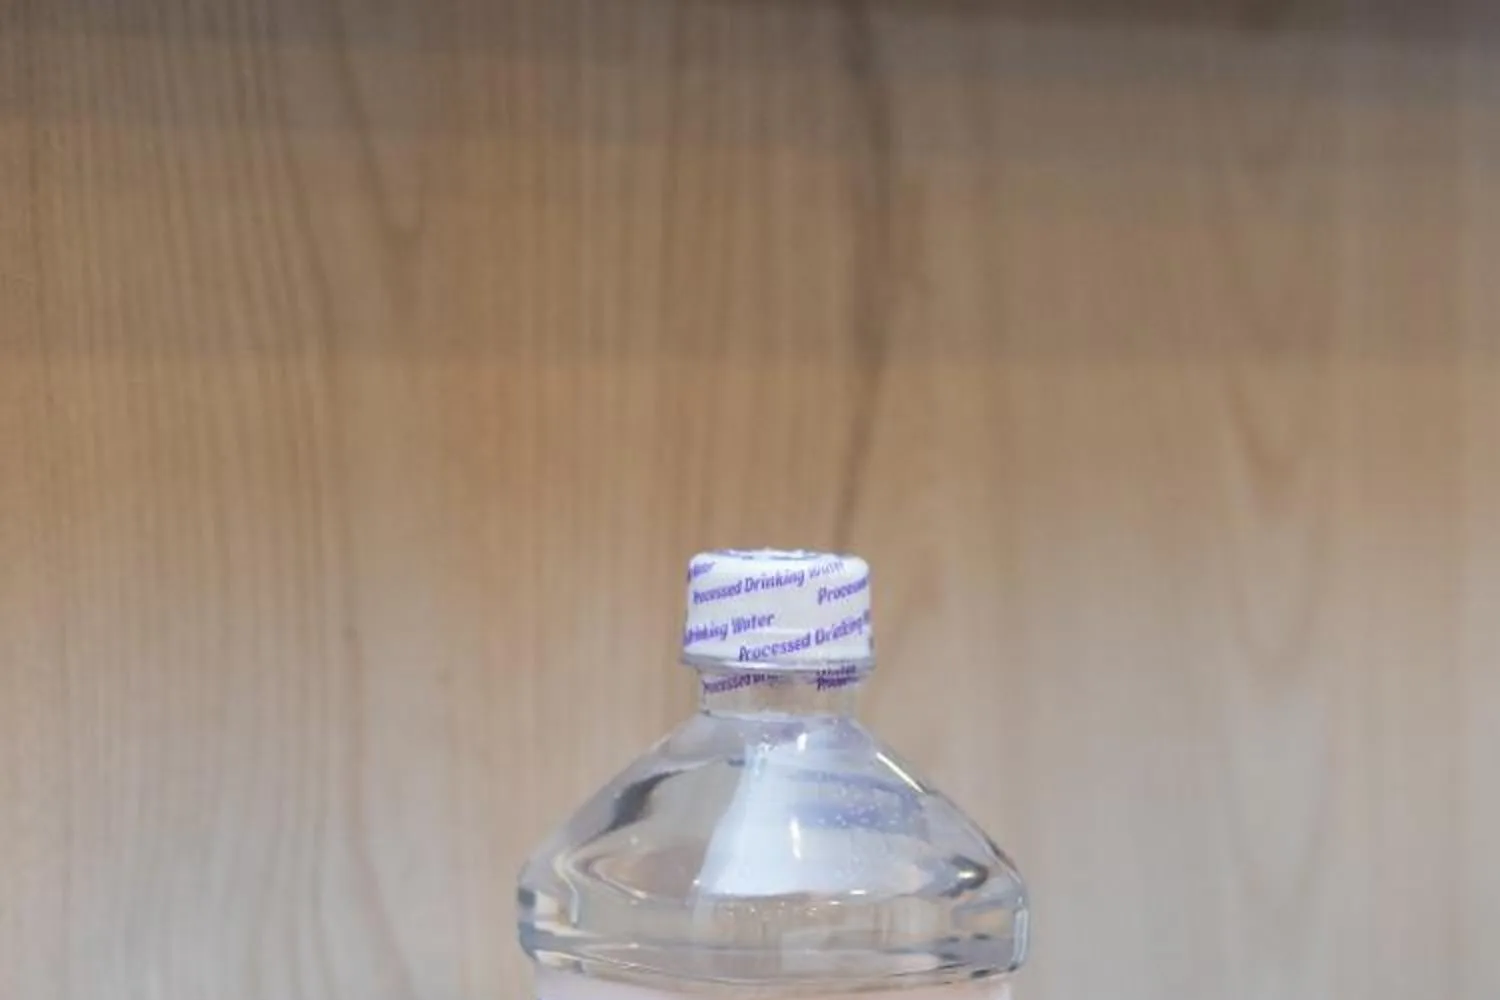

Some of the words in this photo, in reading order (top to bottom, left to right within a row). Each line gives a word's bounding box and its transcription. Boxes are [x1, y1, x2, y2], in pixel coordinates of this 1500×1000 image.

[744, 568, 805, 594] Drinking
[731, 612, 775, 635] Water
[738, 632, 812, 663] Processed
